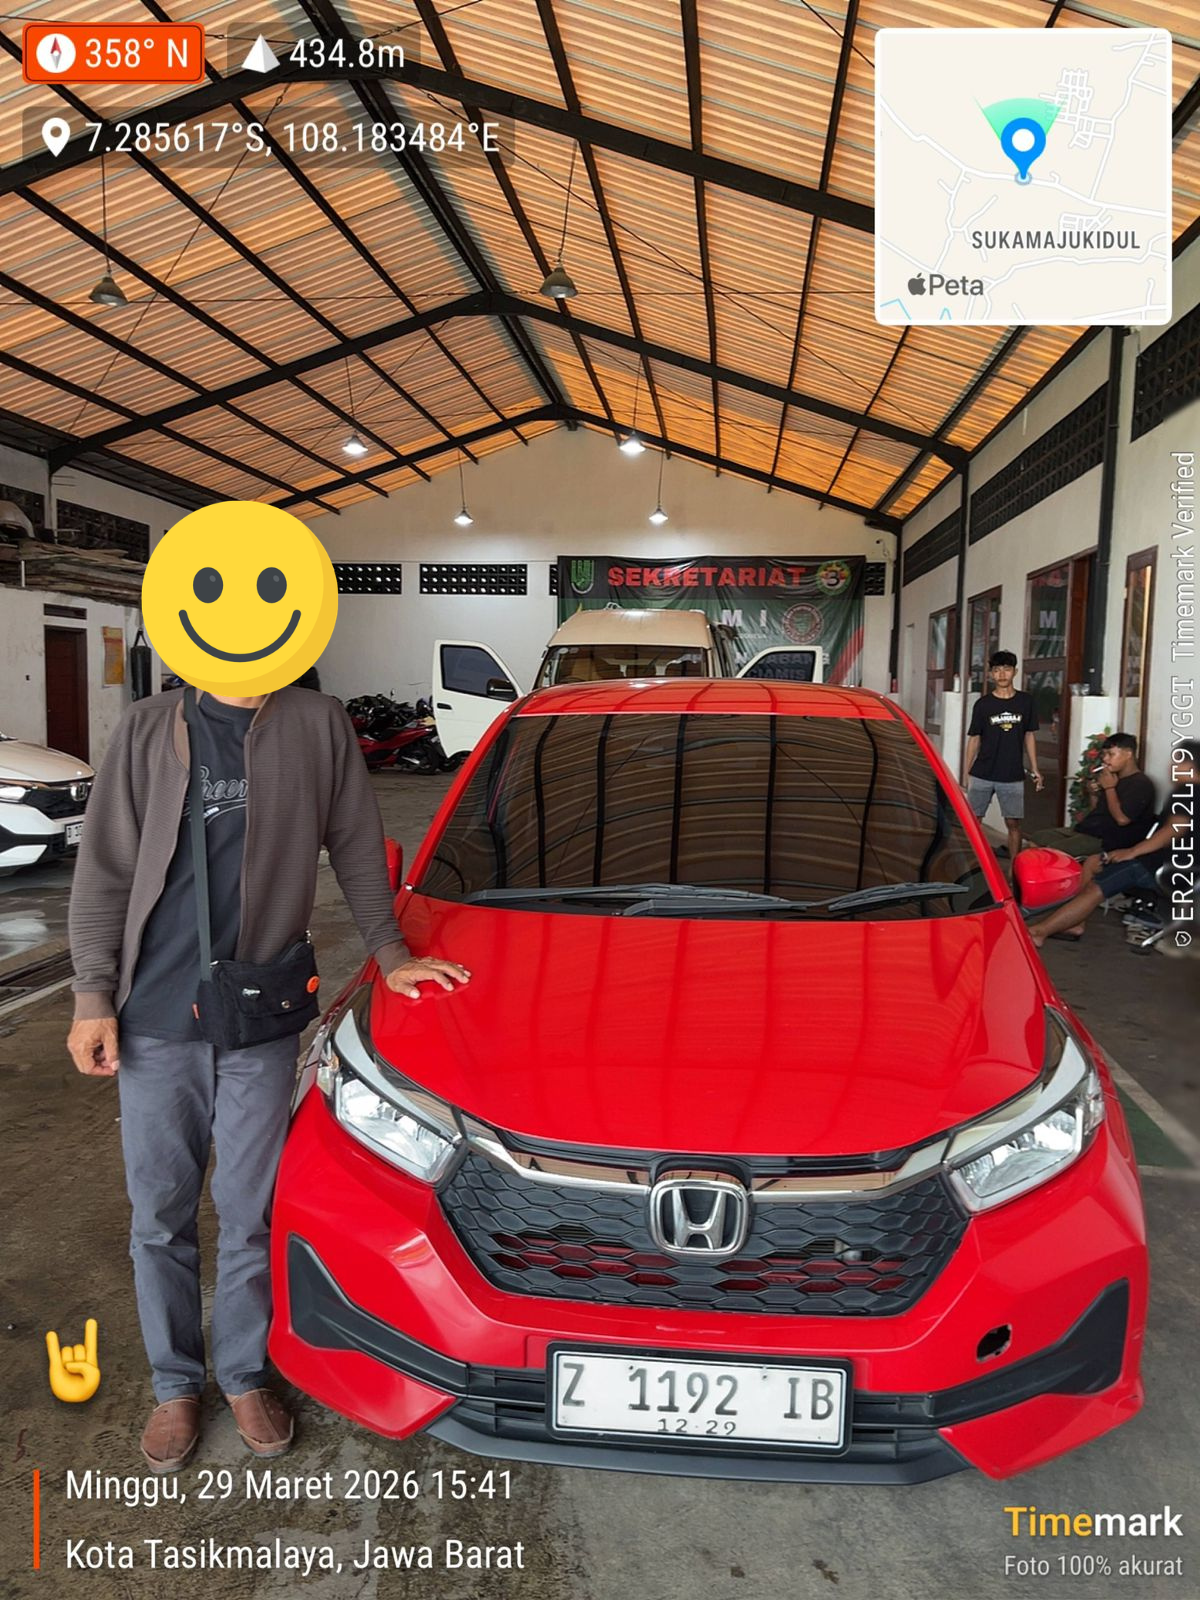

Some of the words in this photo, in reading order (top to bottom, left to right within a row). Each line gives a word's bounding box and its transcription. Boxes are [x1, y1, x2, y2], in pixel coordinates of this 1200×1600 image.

[608, 566, 806, 587] SEKRETARIAT
[562, 1362, 585, 1408] Z
[628, 1368, 739, 1417] 1192
[783, 1376, 835, 1421] IB
